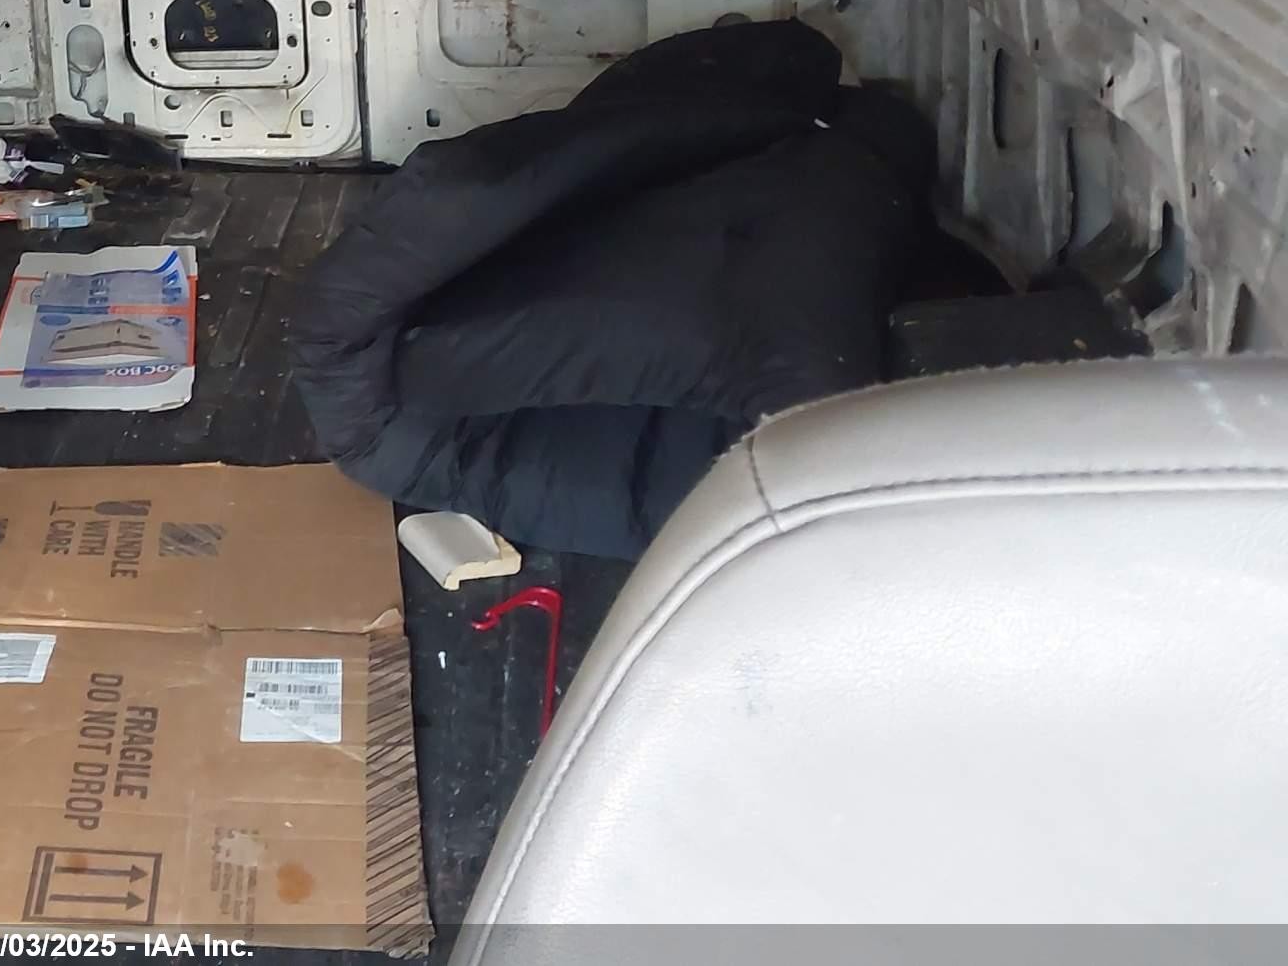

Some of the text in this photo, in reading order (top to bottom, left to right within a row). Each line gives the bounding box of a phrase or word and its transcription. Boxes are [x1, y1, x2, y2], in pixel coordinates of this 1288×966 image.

[105, 366, 141, 377] BOX
[42, 520, 76, 555] CARE
[77, 520, 111, 556] WITH
[110, 521, 145, 578] HANDLE
[64, 673, 124, 831] DO NOT DROP
[113, 706, 159, 800] FRAGILE
